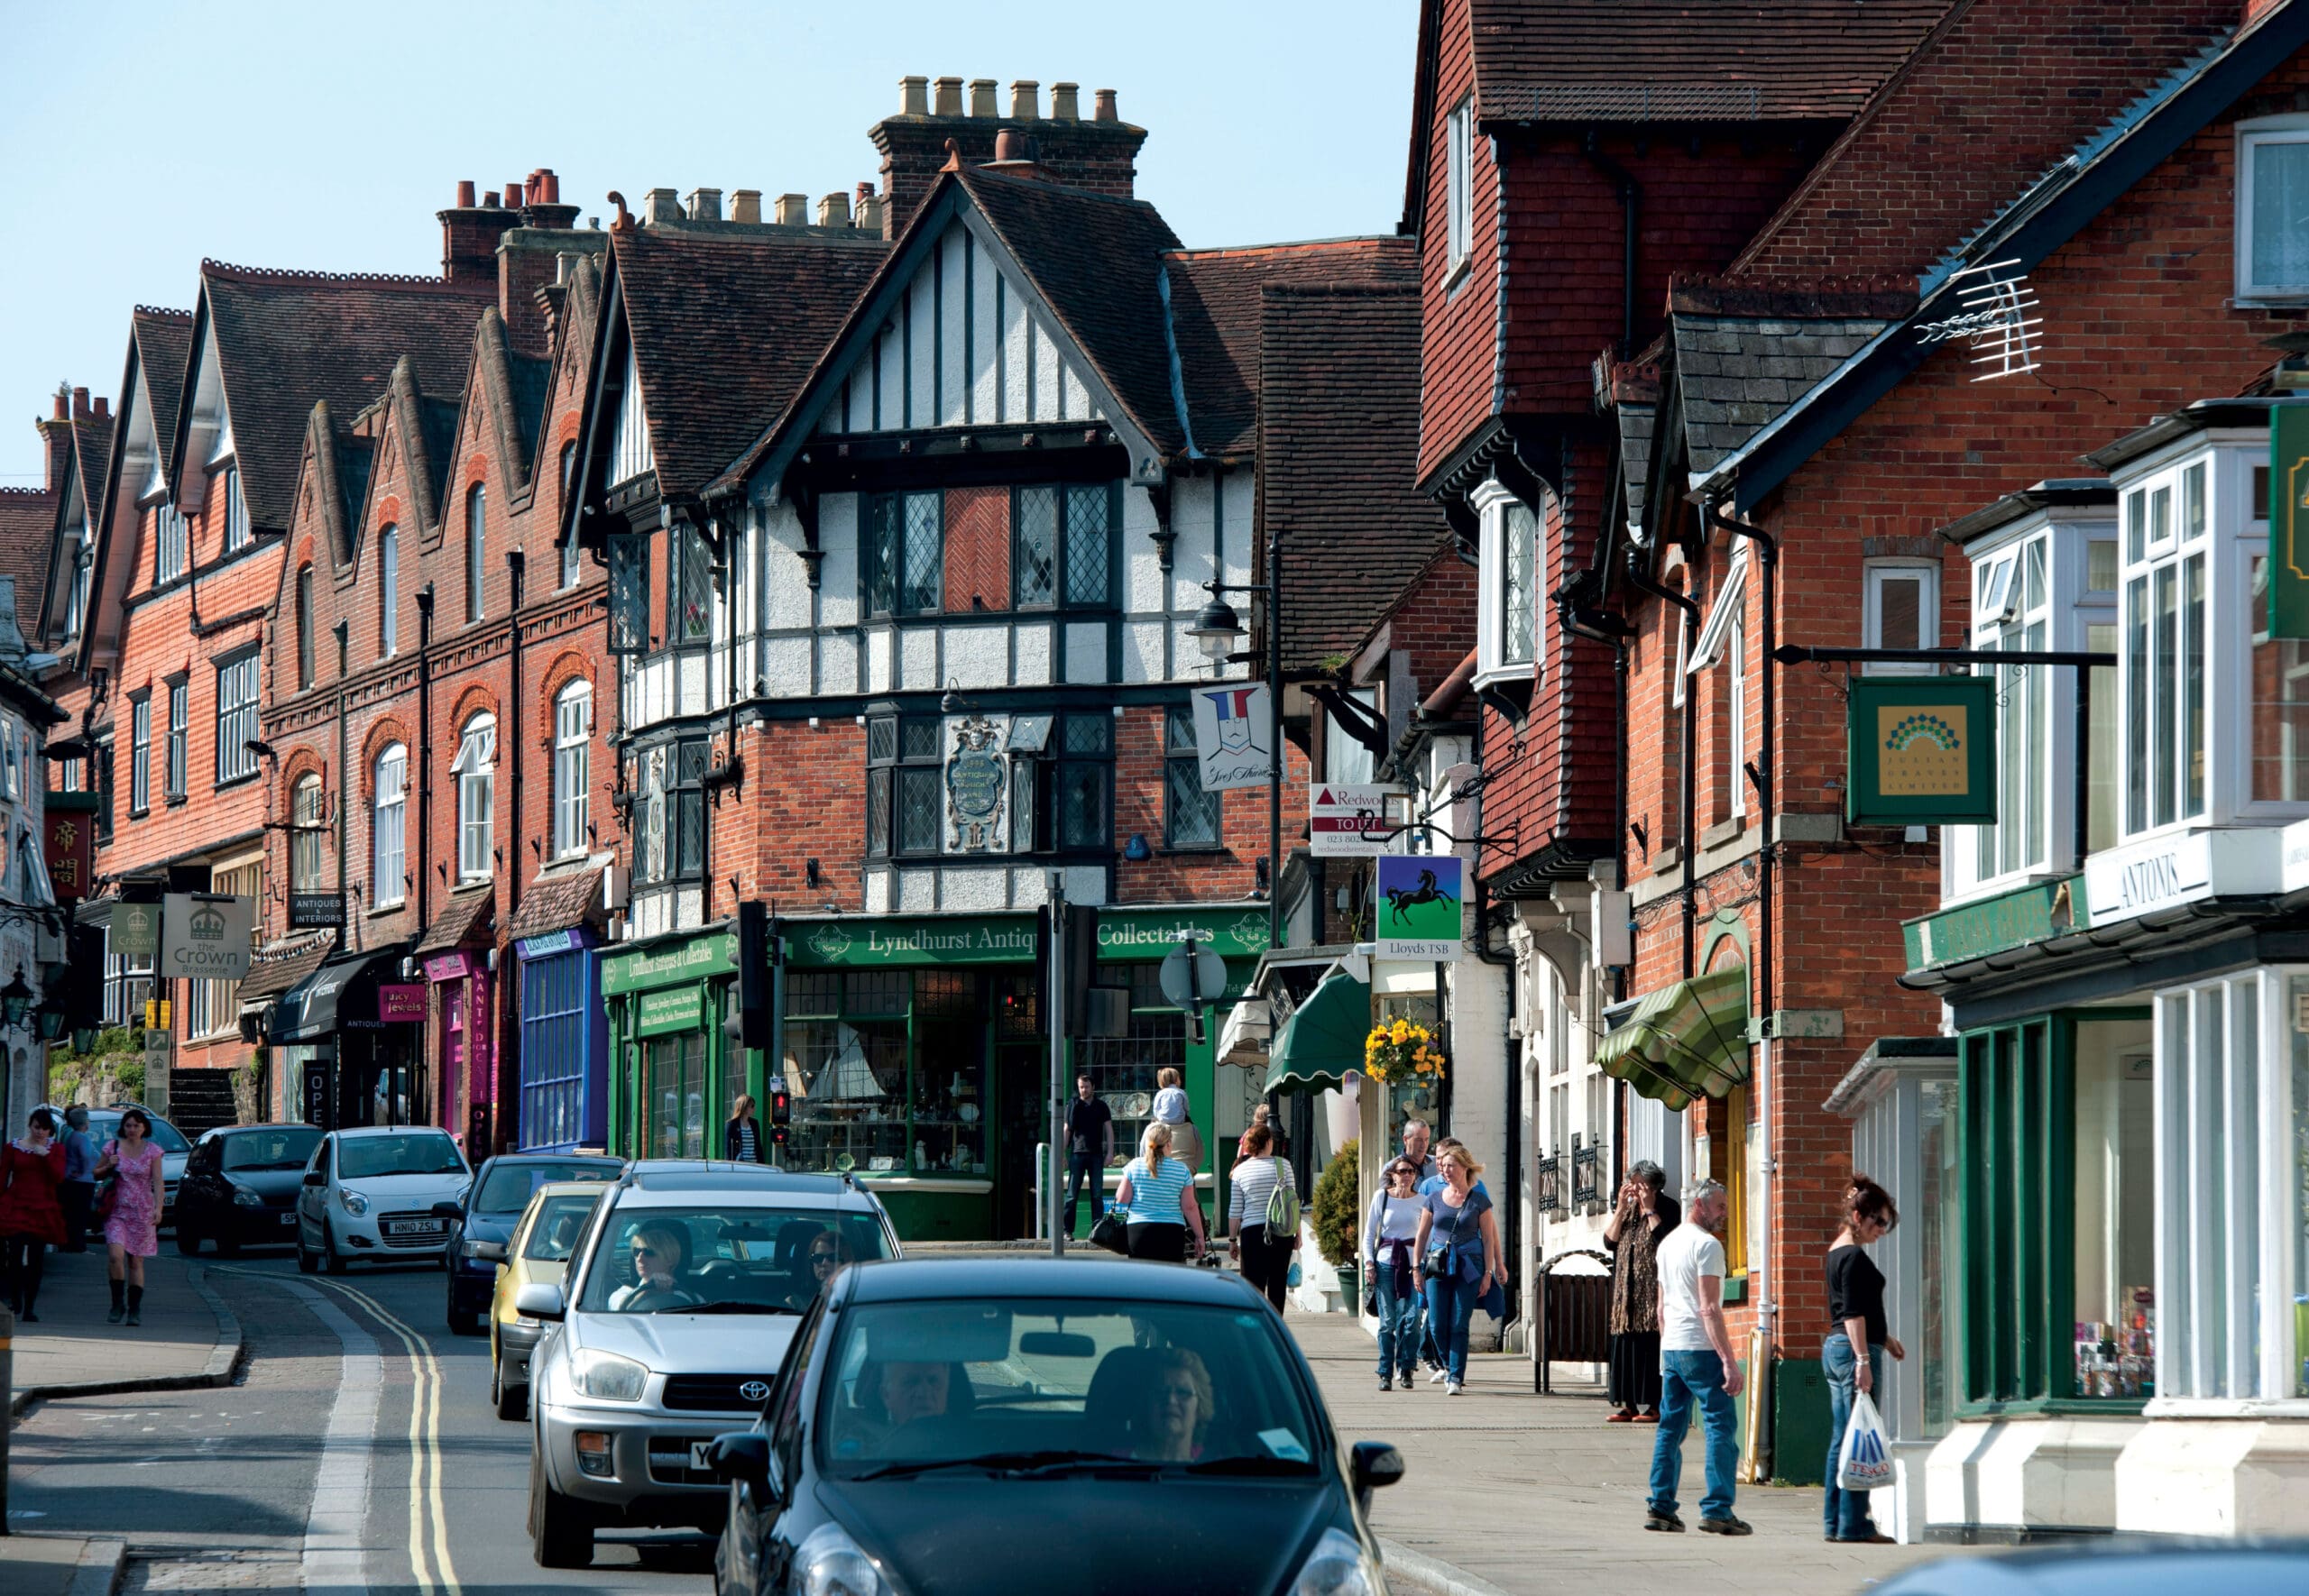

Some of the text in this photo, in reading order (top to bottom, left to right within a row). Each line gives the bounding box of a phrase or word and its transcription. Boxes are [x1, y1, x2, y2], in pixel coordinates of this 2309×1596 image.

[1336, 819, 1378, 830] TO LET
[1318, 845, 1395, 853] redwoodsrentals.co.k
[297, 899, 341, 909] ANTIQUES
[295, 914, 342, 922] INTERIORS
[118, 936, 157, 946] Crown
[868, 929, 972, 957] Lyndhurst
[198, 942, 216, 952] the
[1390, 942, 1449, 957] Lloyds TSB
[174, 947, 238, 966] Crown
[181, 966, 229, 975] Brasserie
[311, 1076, 324, 1124] OPE
[394, 1221, 438, 1233] HN10 ZSL
[1851, 1463, 1890, 1475] TESCO
